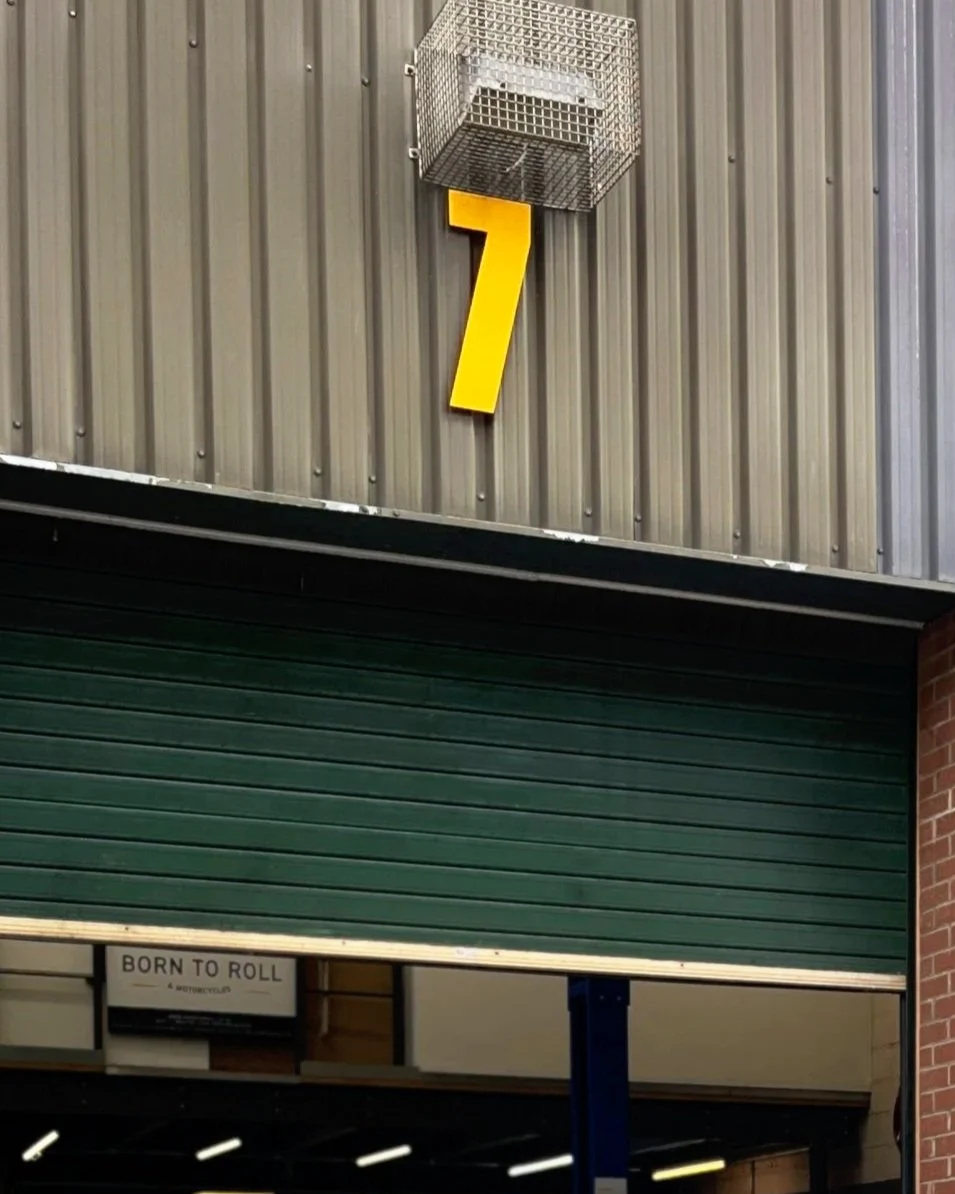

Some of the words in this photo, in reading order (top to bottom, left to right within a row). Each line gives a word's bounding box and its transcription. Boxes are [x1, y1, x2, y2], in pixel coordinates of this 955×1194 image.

[449, 188, 531, 413] 7
[122, 954, 183, 975] BORN
[192, 958, 219, 977] TO
[229, 961, 282, 982] ROLL
